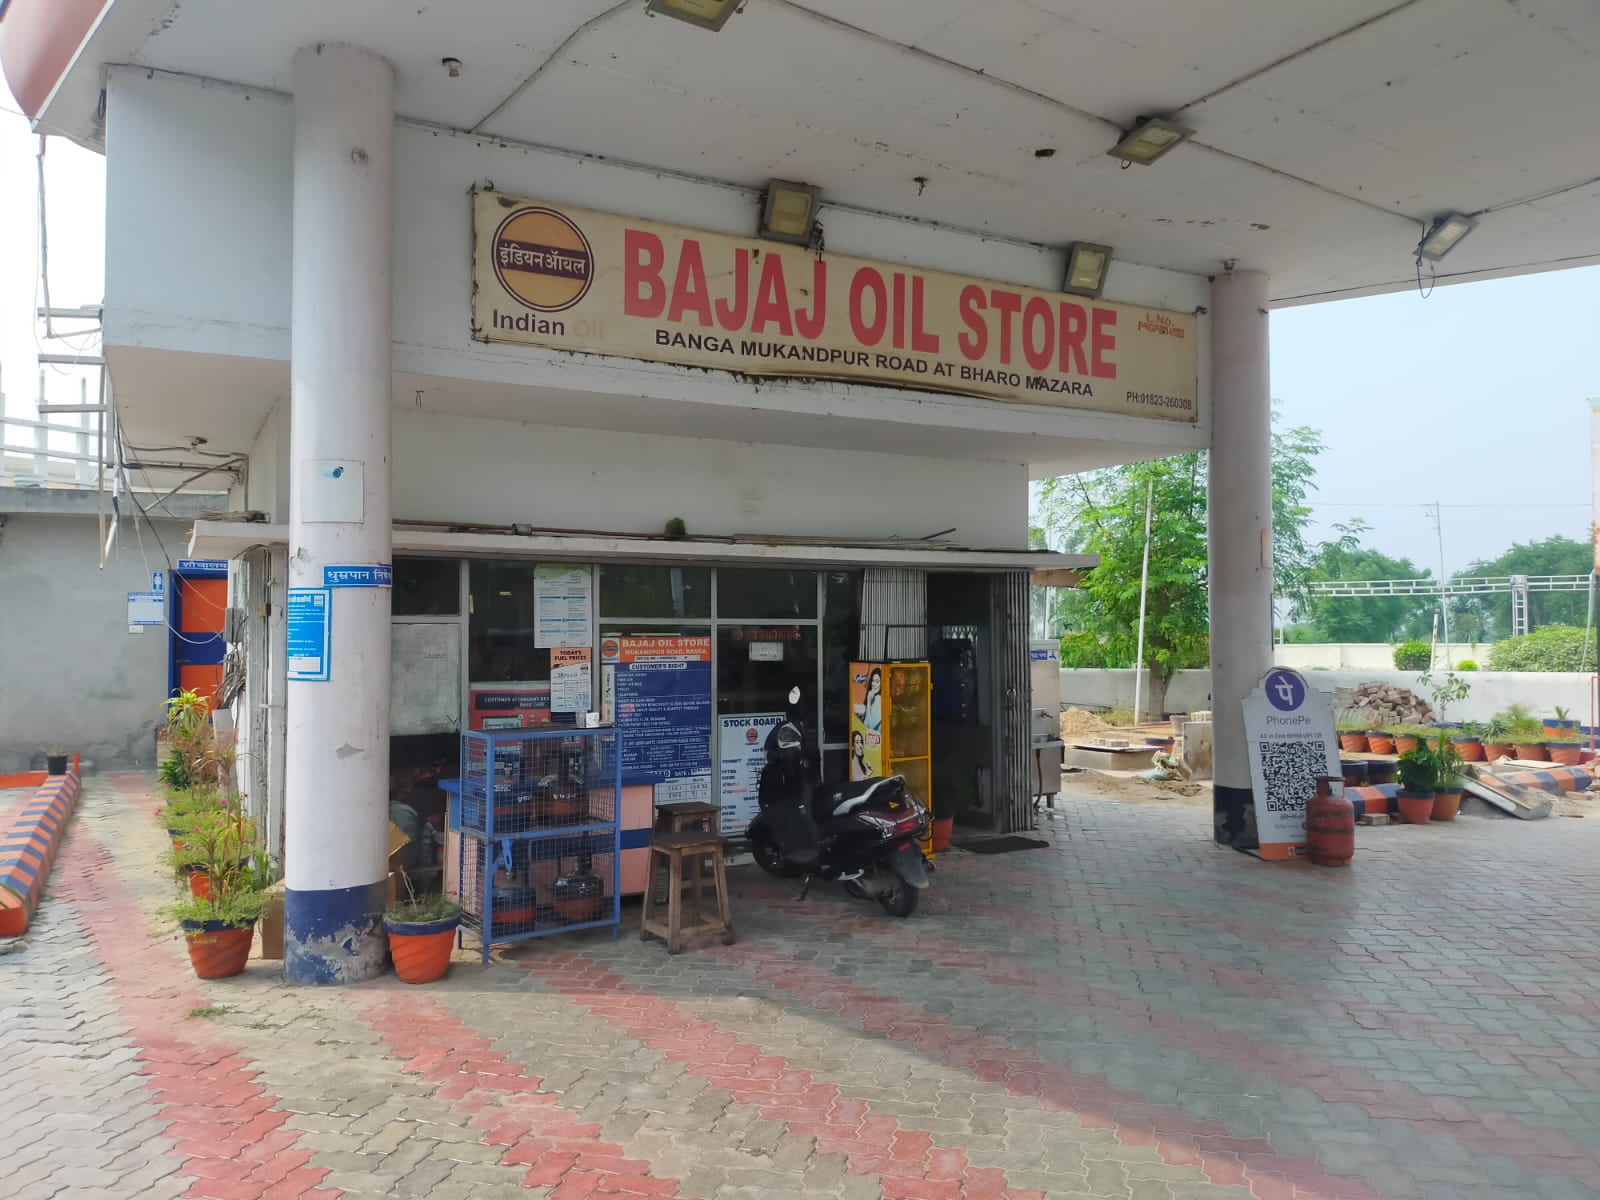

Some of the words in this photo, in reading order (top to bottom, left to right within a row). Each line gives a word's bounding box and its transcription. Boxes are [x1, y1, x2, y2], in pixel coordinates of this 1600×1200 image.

[624, 229, 826, 339] BAJAJ
[849, 267, 939, 353] OIL
[958, 285, 1117, 378] STORE
[492, 309, 565, 336] Indian
[655, 328, 735, 355] BANGA
[740, 340, 870, 367] MUKANDPUR
[875, 353, 928, 374] ROAD
[933, 362, 956, 377] AT
[960, 365, 1021, 387] BHARO
[1025, 375, 1094, 397] MAZARA
[622, 639, 655, 648] BAJAJ
[657, 639, 675, 647] OIL
[677, 638, 710, 647] STORE
[723, 718, 752, 728] STOCK
[753, 717, 782, 726] BOARD
[1265, 715, 1312, 726] PhonePe
